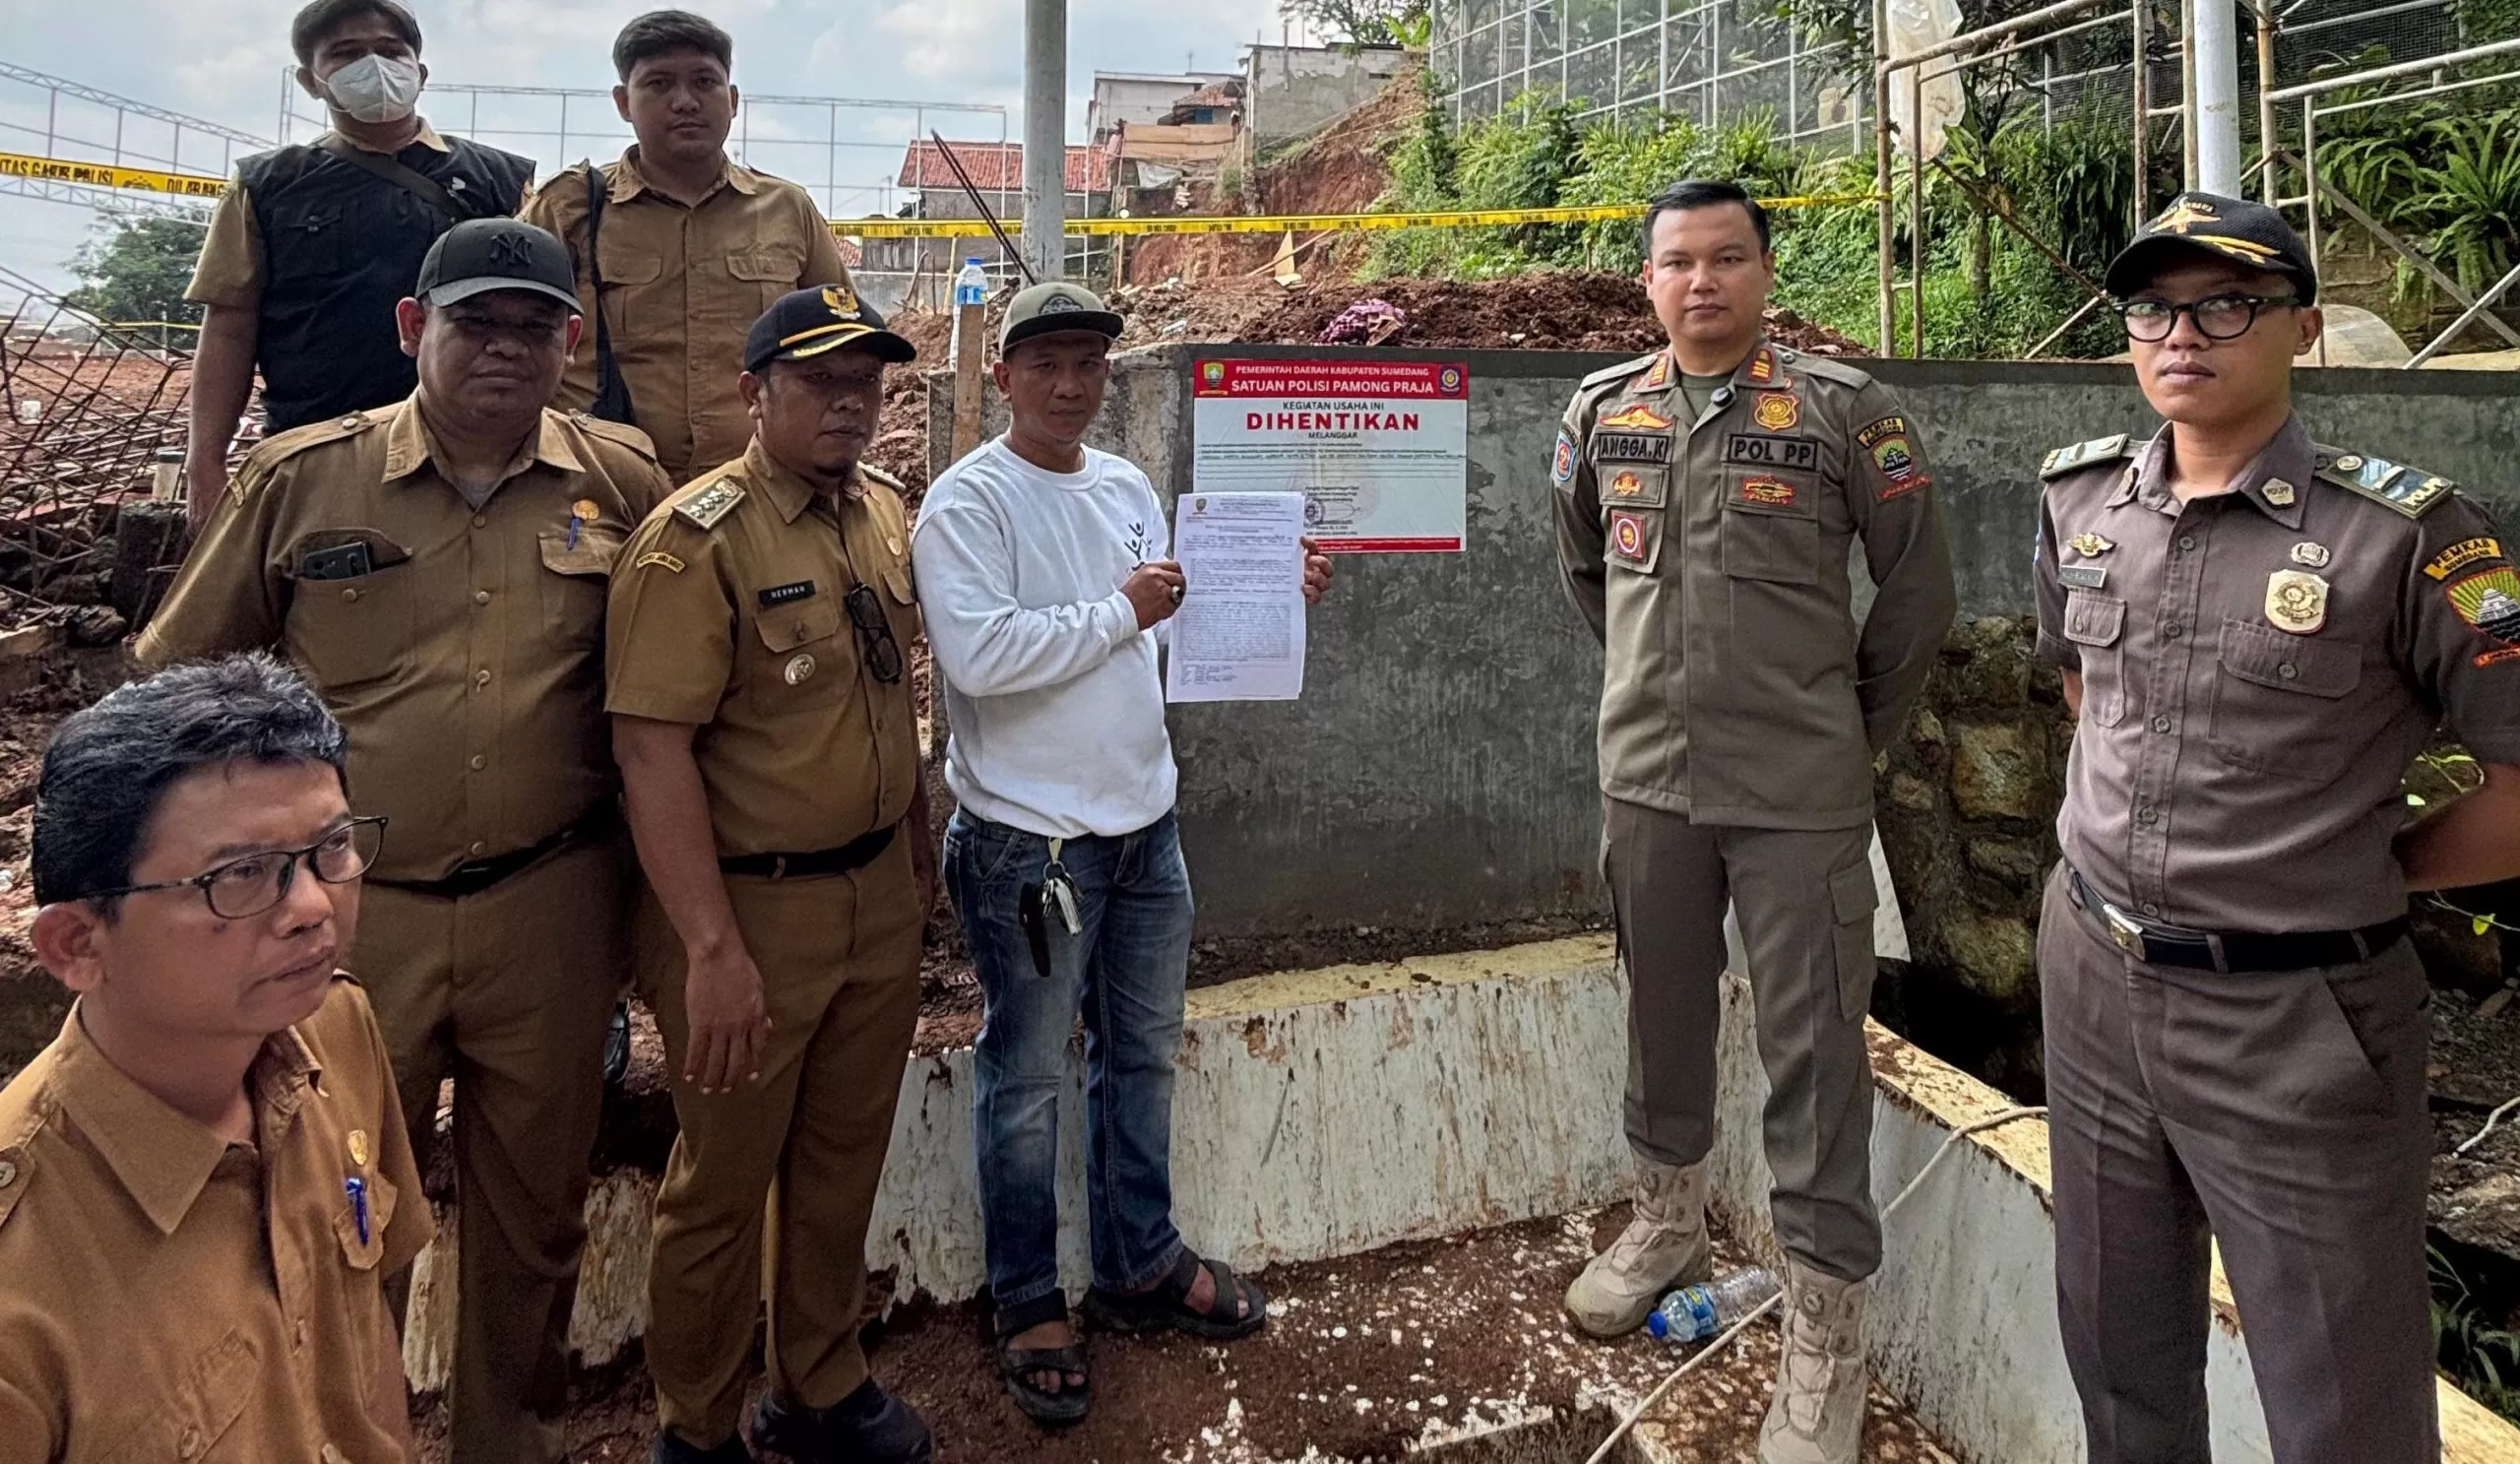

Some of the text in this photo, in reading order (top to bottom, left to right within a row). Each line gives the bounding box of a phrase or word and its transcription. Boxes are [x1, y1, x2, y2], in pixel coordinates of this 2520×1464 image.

[1235, 365, 1292, 374] PEMERINTAH
[1330, 366, 1380, 375] KABUPATEN
[1381, 367, 1429, 376] SUMEDANG
[1231, 380, 1434, 394] SATUAN POLISI PAMONG PRAJA
[1283, 401, 1384, 411] KEGIATAN USAHA INI
[1246, 413, 1419, 430] DIHENTIKAN
[1601, 436, 1664, 459] ANGGA.K
[1734, 439, 1811, 465] POL PP
[2433, 539, 2491, 566] PEMKAB
[771, 585, 805, 599] HERMAN
